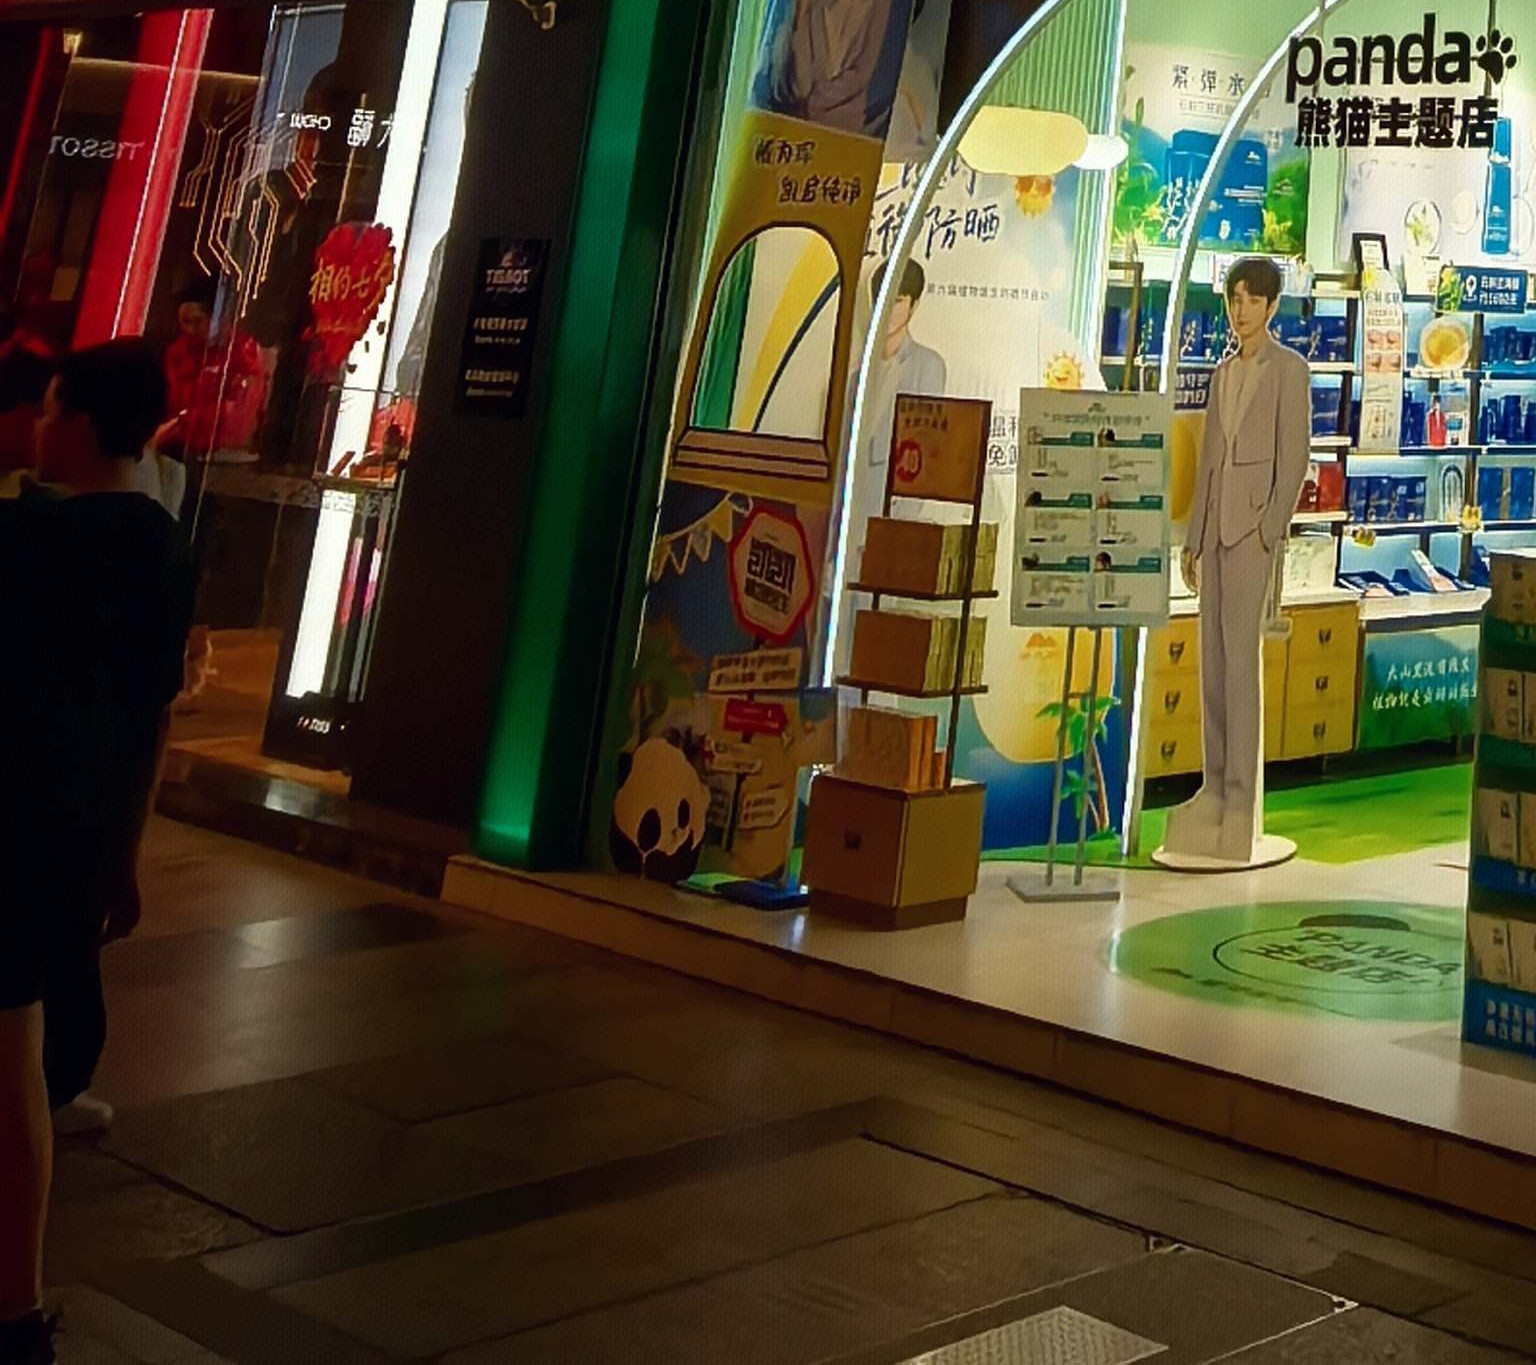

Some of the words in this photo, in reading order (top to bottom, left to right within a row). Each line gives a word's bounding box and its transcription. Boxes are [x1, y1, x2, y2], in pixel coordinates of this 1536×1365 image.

[1287, 13, 1471, 103] panda
[1294, 97, 1499, 149] 熊猫主题店
